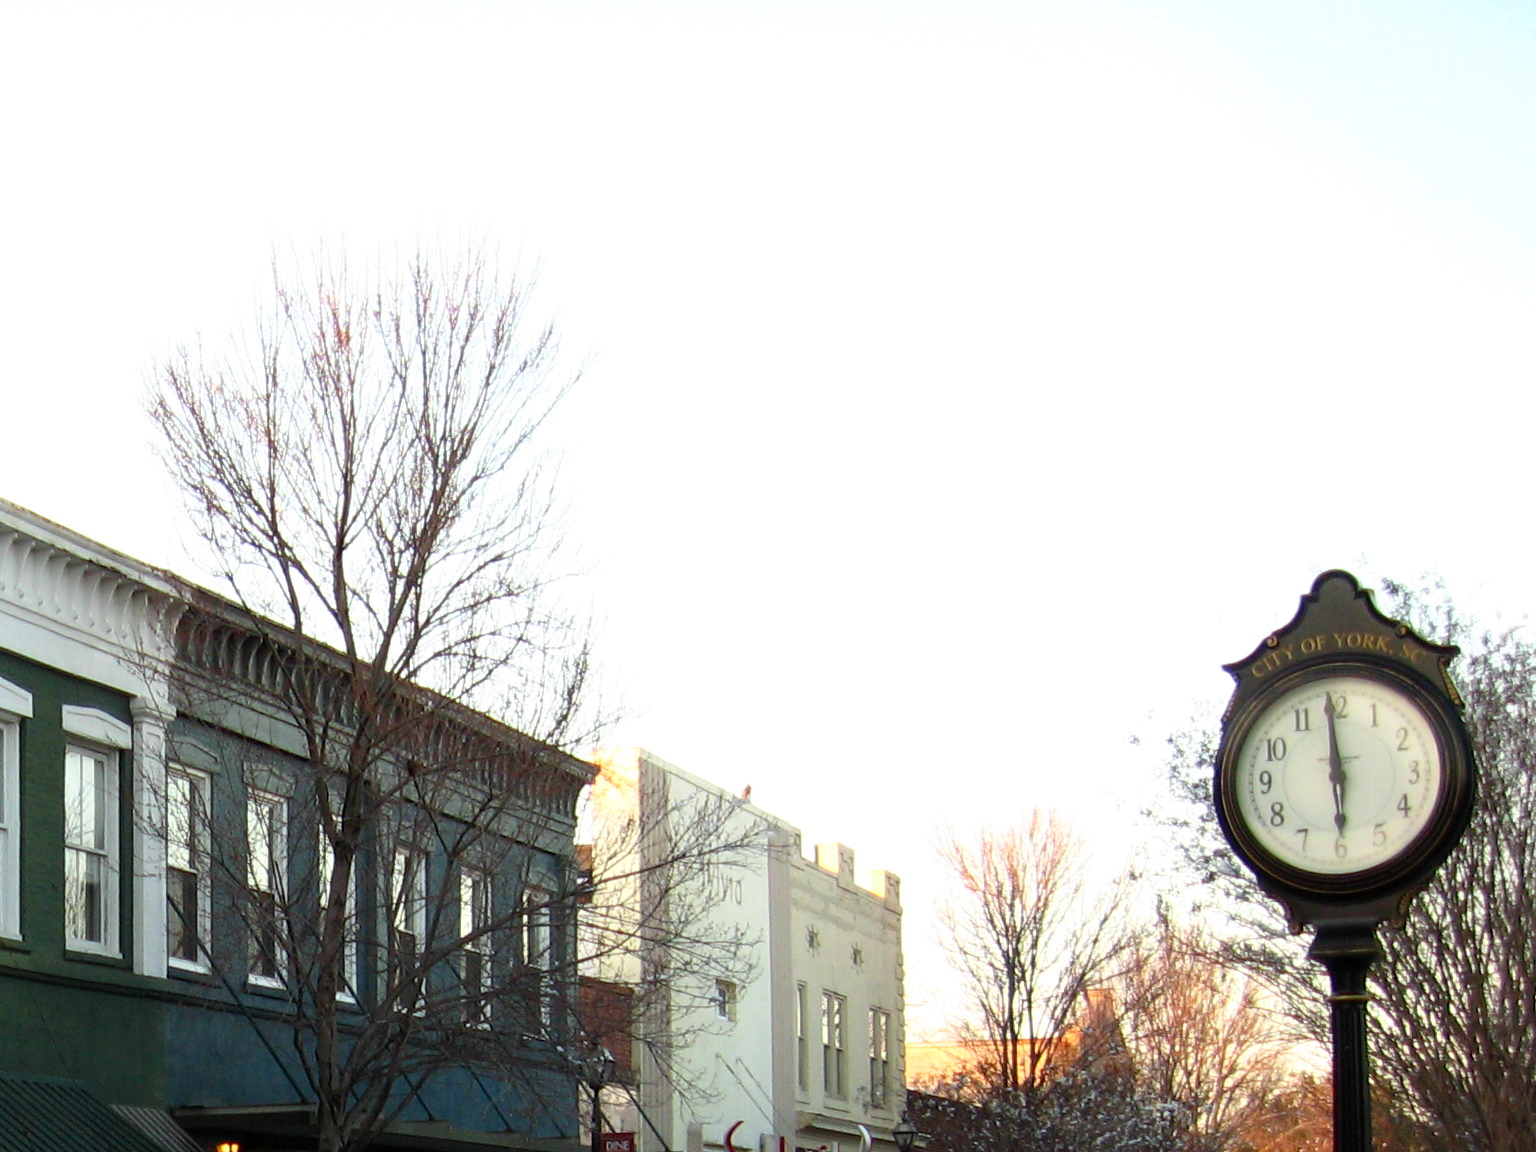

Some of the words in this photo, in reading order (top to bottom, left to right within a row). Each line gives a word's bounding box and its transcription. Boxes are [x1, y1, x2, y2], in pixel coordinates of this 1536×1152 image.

[1251, 644, 1293, 678] CITY
[1300, 635, 1326, 654] OF
[1399, 643, 1424, 663] SC
[1293, 707, 1311, 732] 11
[1369, 703, 1379, 728] 1
[1266, 737, 1287, 762] 10
[1397, 727, 1410, 752] 2
[1259, 769, 1272, 794] 9
[1408, 760, 1420, 785] 3
[1270, 802, 1284, 828] 8
[1397, 793, 1411, 818] 4
[1296, 829, 1310, 851] 7
[1372, 823, 1386, 848] 5
[1334, 837, 1348, 860] 6
[606, 1140, 631, 1152] DINE
